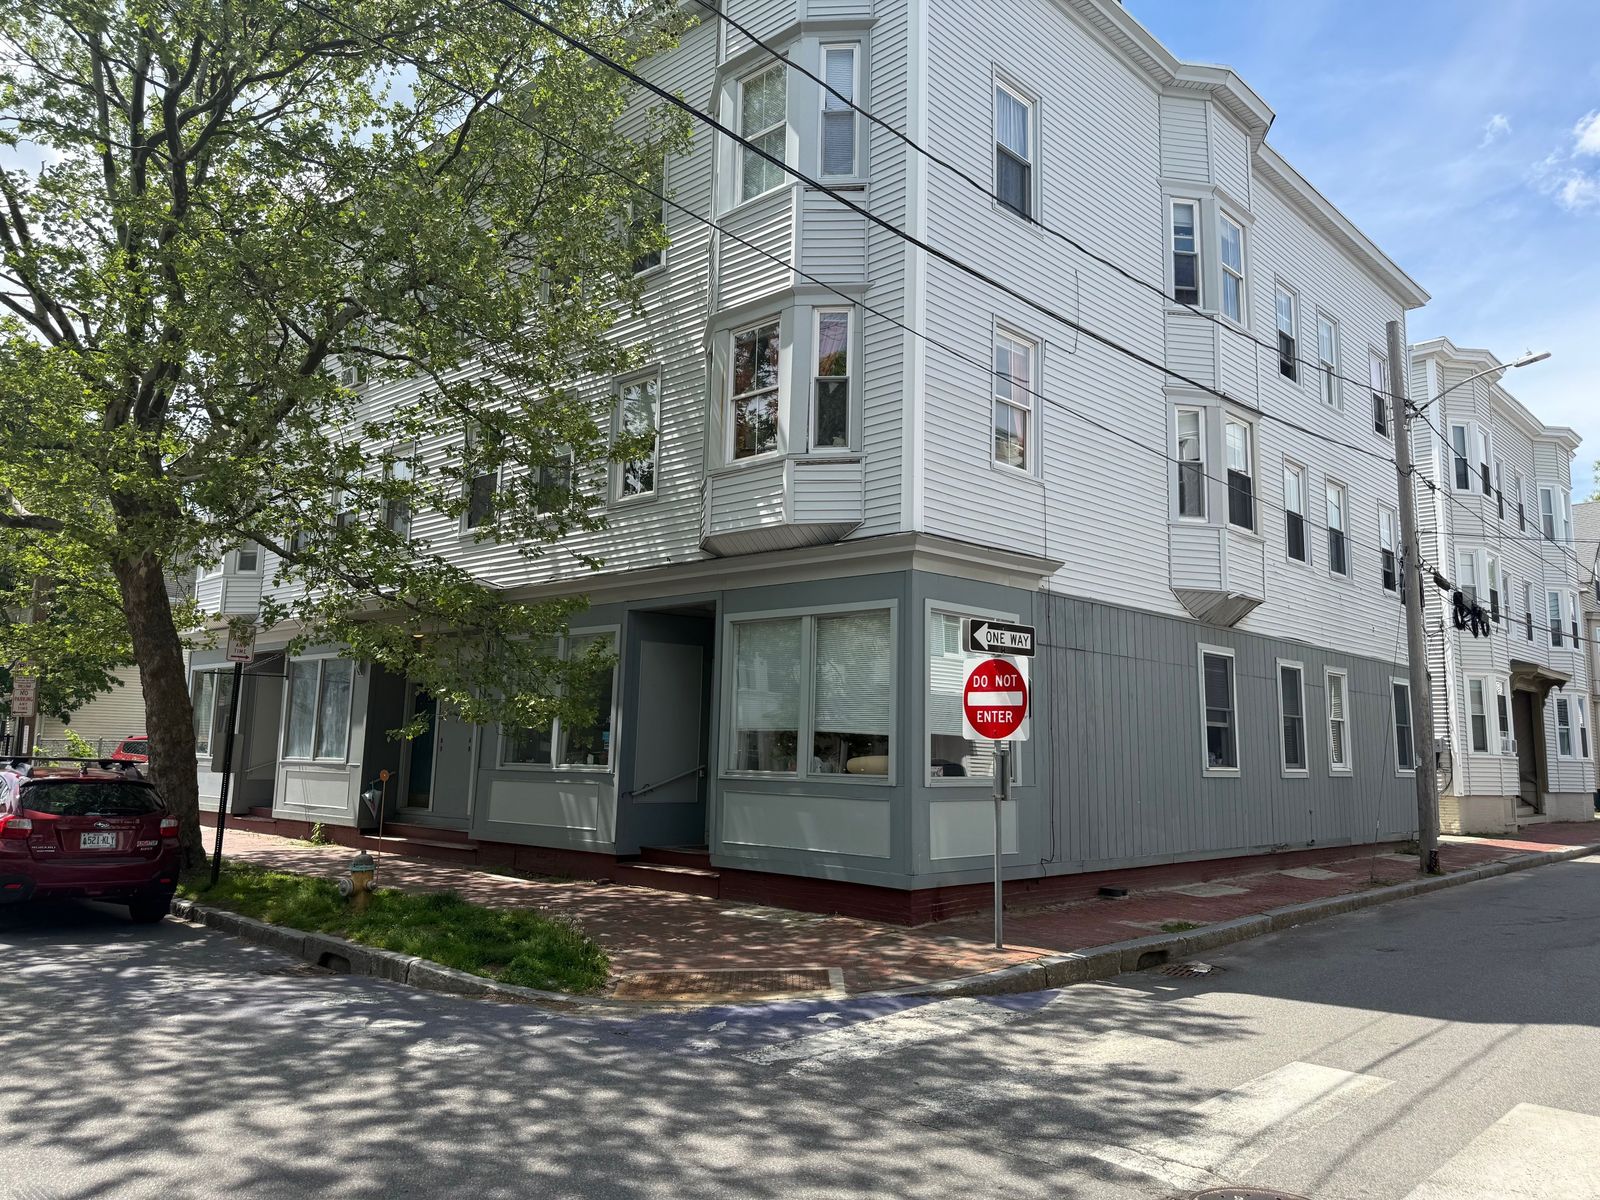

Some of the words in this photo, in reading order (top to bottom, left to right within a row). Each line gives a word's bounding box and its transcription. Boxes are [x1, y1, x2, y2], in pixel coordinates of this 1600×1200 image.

[986, 631, 1006, 644] ONE
[1010, 633, 1030, 647] WAY
[973, 675, 988, 687] DO
[995, 674, 1017, 687] NOT
[977, 711, 1013, 723] ENTER
